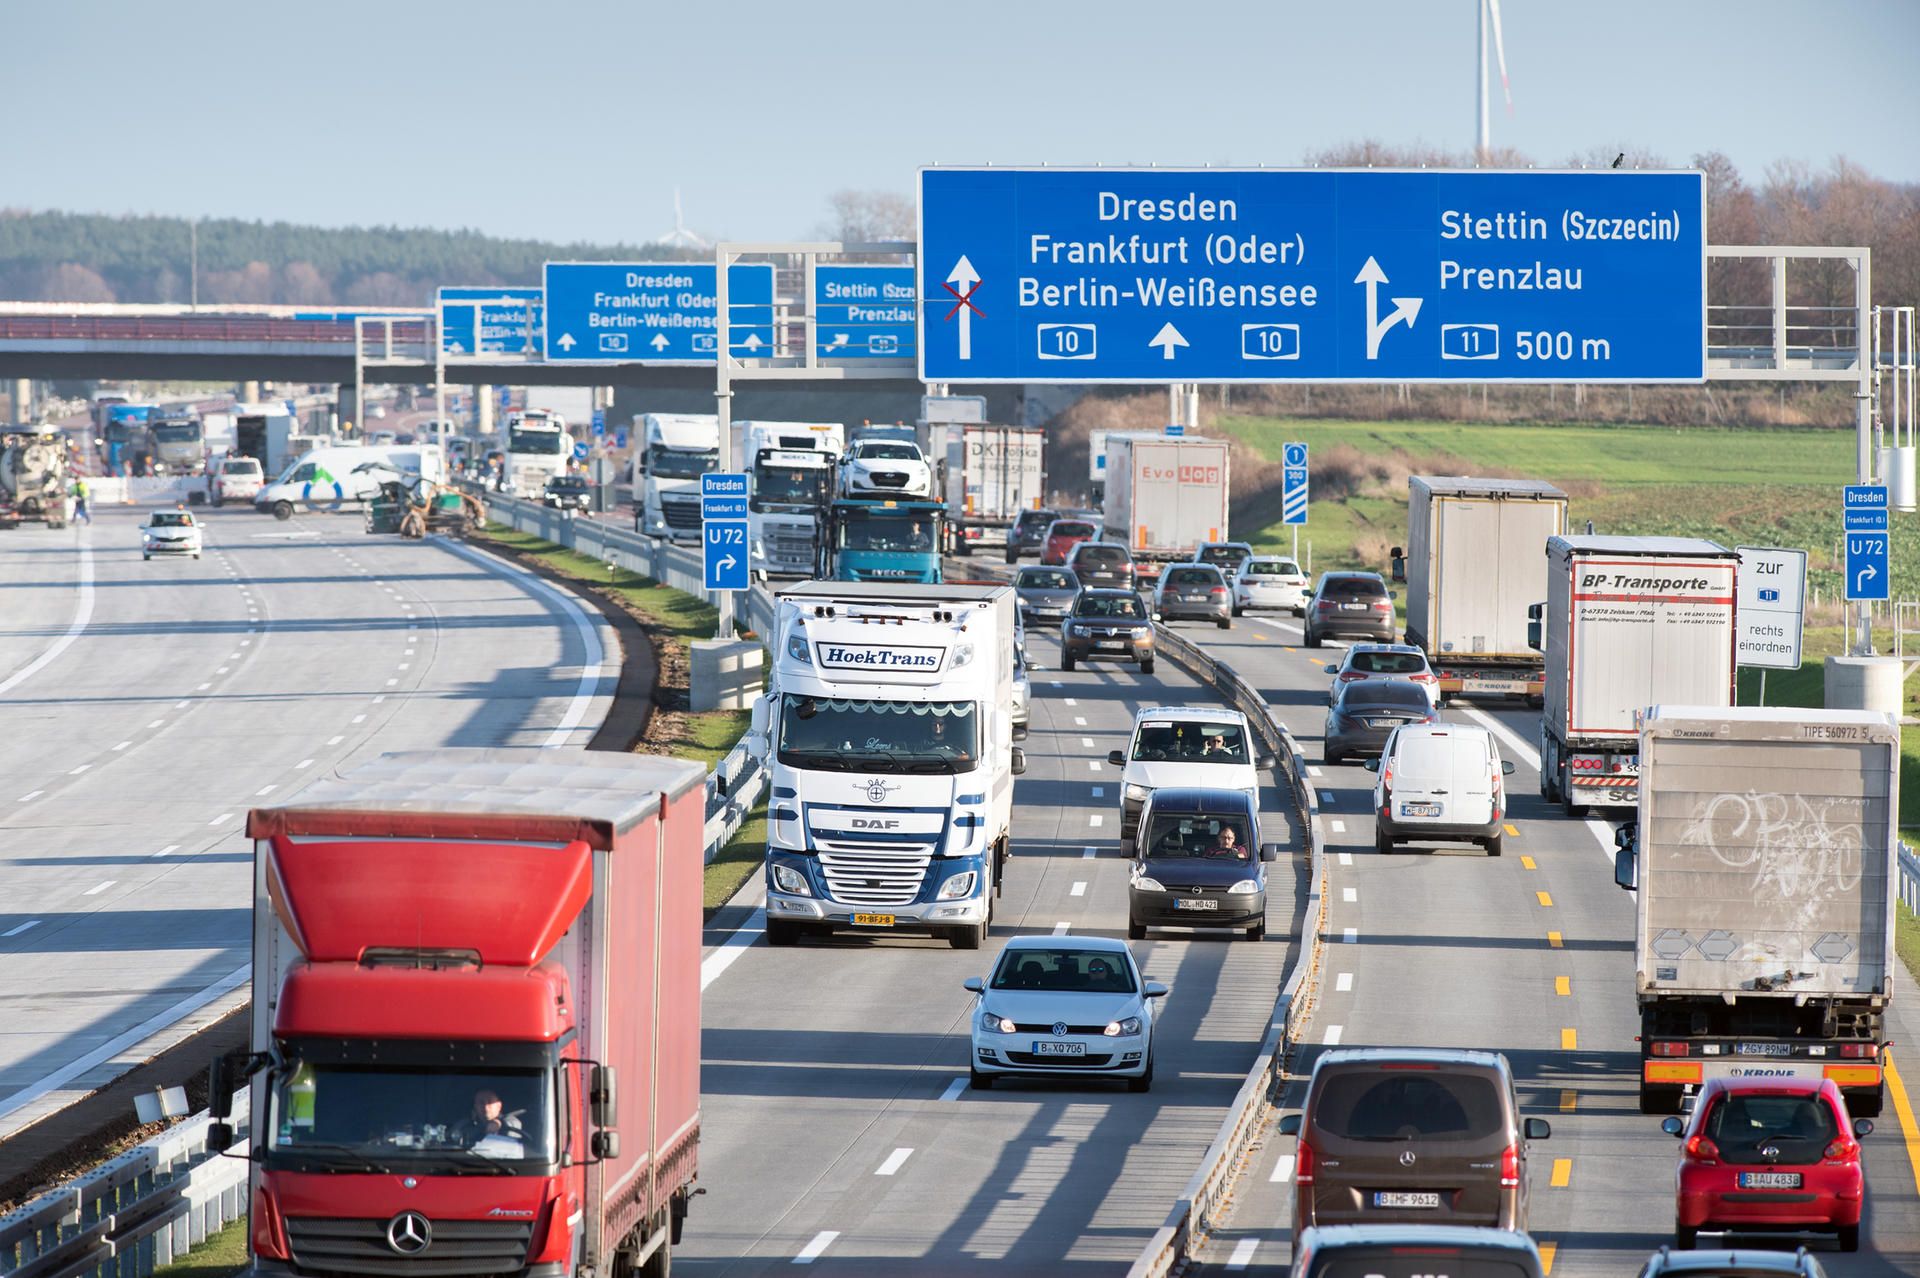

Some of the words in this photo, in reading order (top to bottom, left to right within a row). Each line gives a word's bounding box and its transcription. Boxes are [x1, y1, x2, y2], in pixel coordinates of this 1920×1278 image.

[1099, 191, 1237, 221] Dresden
[1440, 211, 1547, 239] Stettin
[1562, 209, 1680, 241] (Szczecin)
[1031, 235, 1188, 263] Frankfurt
[1205, 233, 1304, 265] (Oder)
[626, 273, 692, 288] Dresden
[1440, 261, 1582, 289] Prenzlau
[825, 282, 877, 298] Stettin
[1019, 277, 1317, 306] Berlin-Weißensee
[595, 292, 669, 308] Frankfurt
[608, 336, 619, 348] 10
[701, 336, 713, 348] 10
[1055, 331, 1079, 353] 10
[1259, 331, 1282, 353] 10
[1461, 331, 1480, 353] 11
[1516, 331, 1573, 360] 500
[1582, 337, 1610, 360] m
[1293, 449, 1298, 461] 1
[706, 479, 743, 491] Dresden
[1848, 491, 1884, 503] Dresden
[705, 504, 732, 512] Frankfurt
[1847, 516, 1873, 524] Frankfurt
[709, 529, 720, 544] U
[724, 529, 743, 544] 72
[1851, 540, 1862, 555] U
[1866, 540, 1883, 555] 72
[1756, 562, 1784, 575] zur
[1764, 591, 1772, 600] 11
[1750, 624, 1784, 636] rechts
[1739, 639, 1793, 654] einordnen
[1683, 730, 1716, 738] KRONE
[1803, 726, 1823, 738] TIPE
[1825, 727, 1857, 739] 560972
[851, 818, 900, 830] DAF
[1744, 1069, 1795, 1077] KRONE
[1411, 1194, 1437, 1206] 9612
